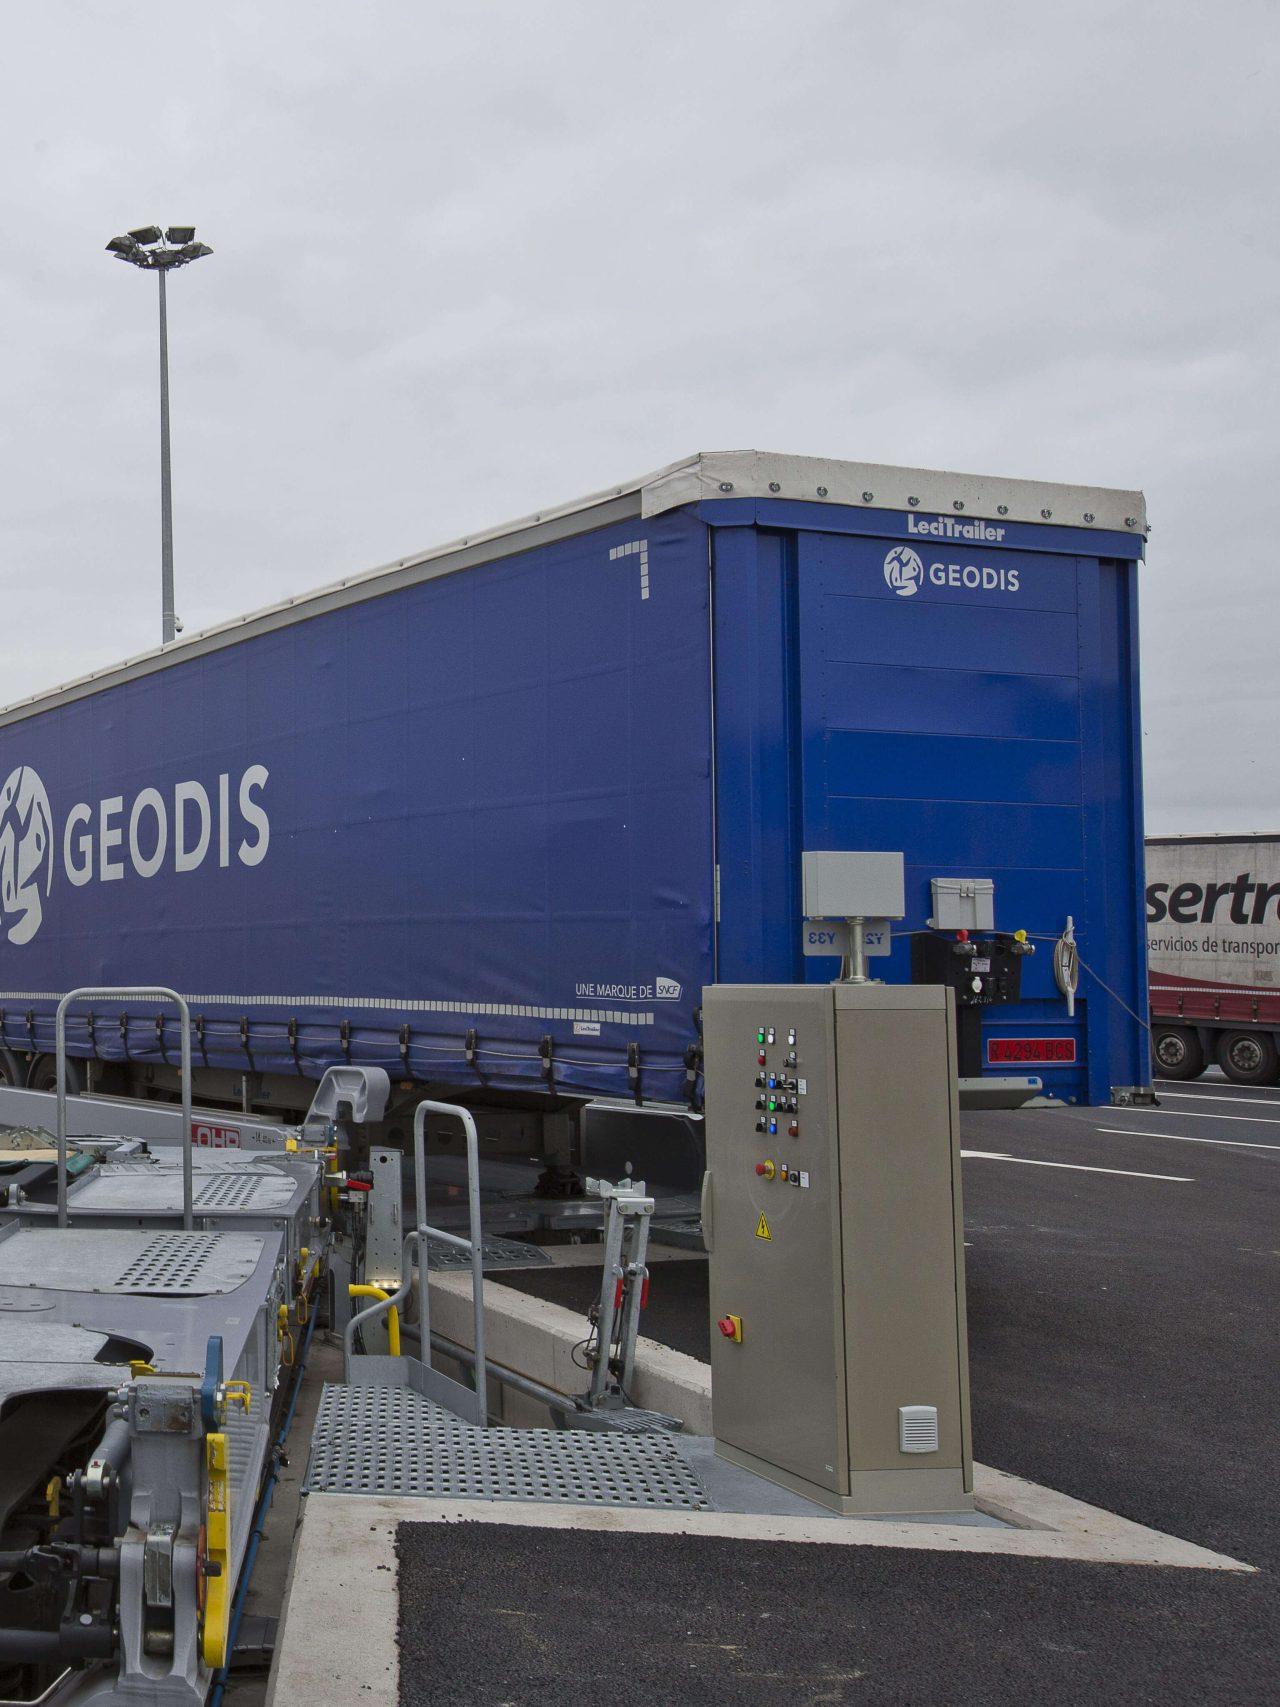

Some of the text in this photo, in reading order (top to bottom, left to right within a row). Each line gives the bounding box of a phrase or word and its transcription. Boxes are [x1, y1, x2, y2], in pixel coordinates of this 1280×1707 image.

[907, 513, 1006, 541] LeciTrailer
[929, 562, 1020, 592] GEODIS
[63, 764, 270, 887] GEODIS
[1145, 872, 1280, 925] sertr
[1201, 936, 1218, 953] de
[576, 983, 679, 998] UNE MARQUE DE SNCF
